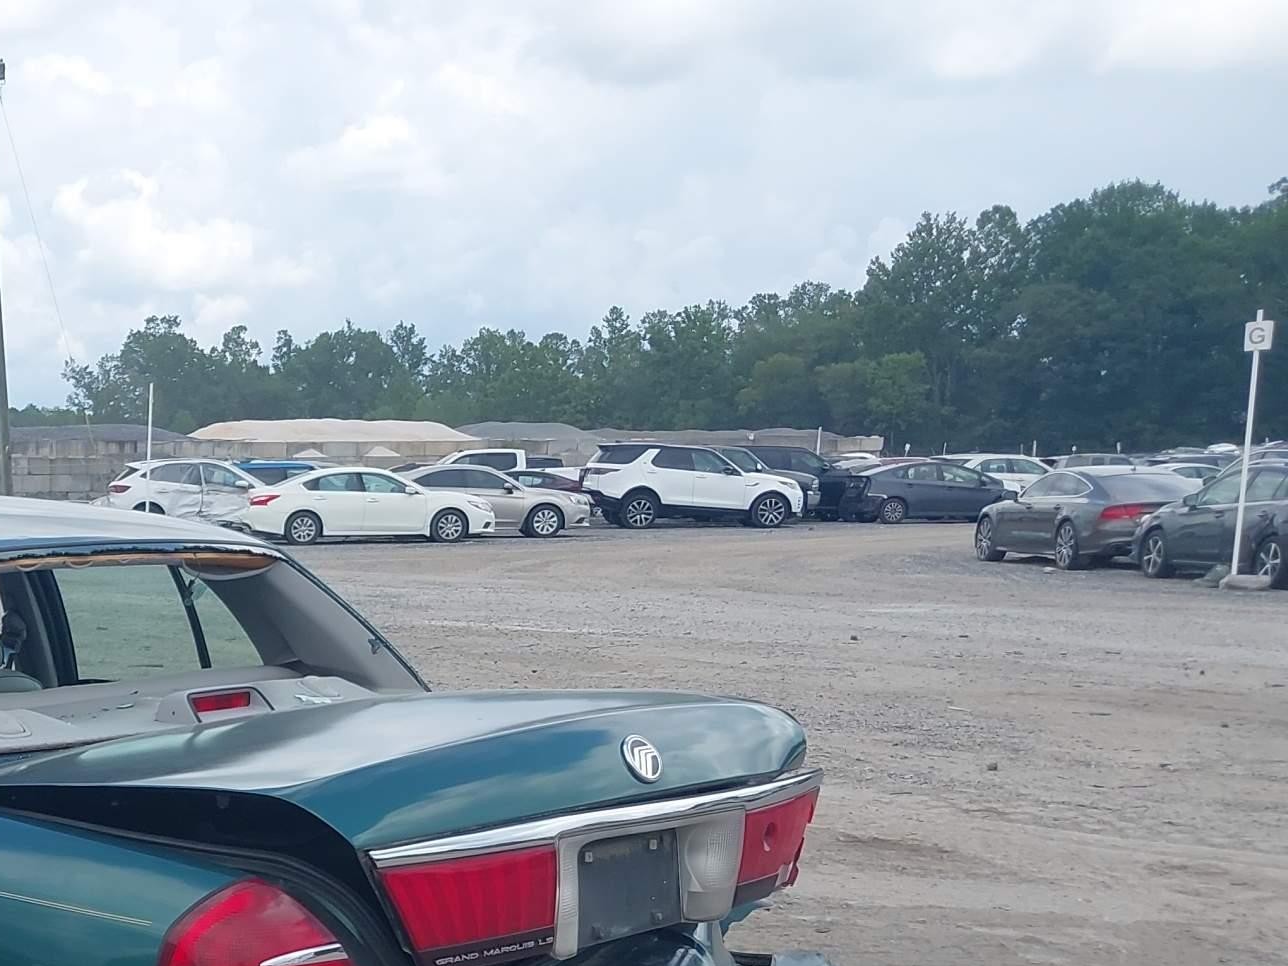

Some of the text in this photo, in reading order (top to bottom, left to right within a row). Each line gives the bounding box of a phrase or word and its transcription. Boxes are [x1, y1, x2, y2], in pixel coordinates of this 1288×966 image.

[1249, 327, 1265, 344] G
[435, 952, 479, 966] GRAND
[483, 941, 534, 956] MARQUIS
